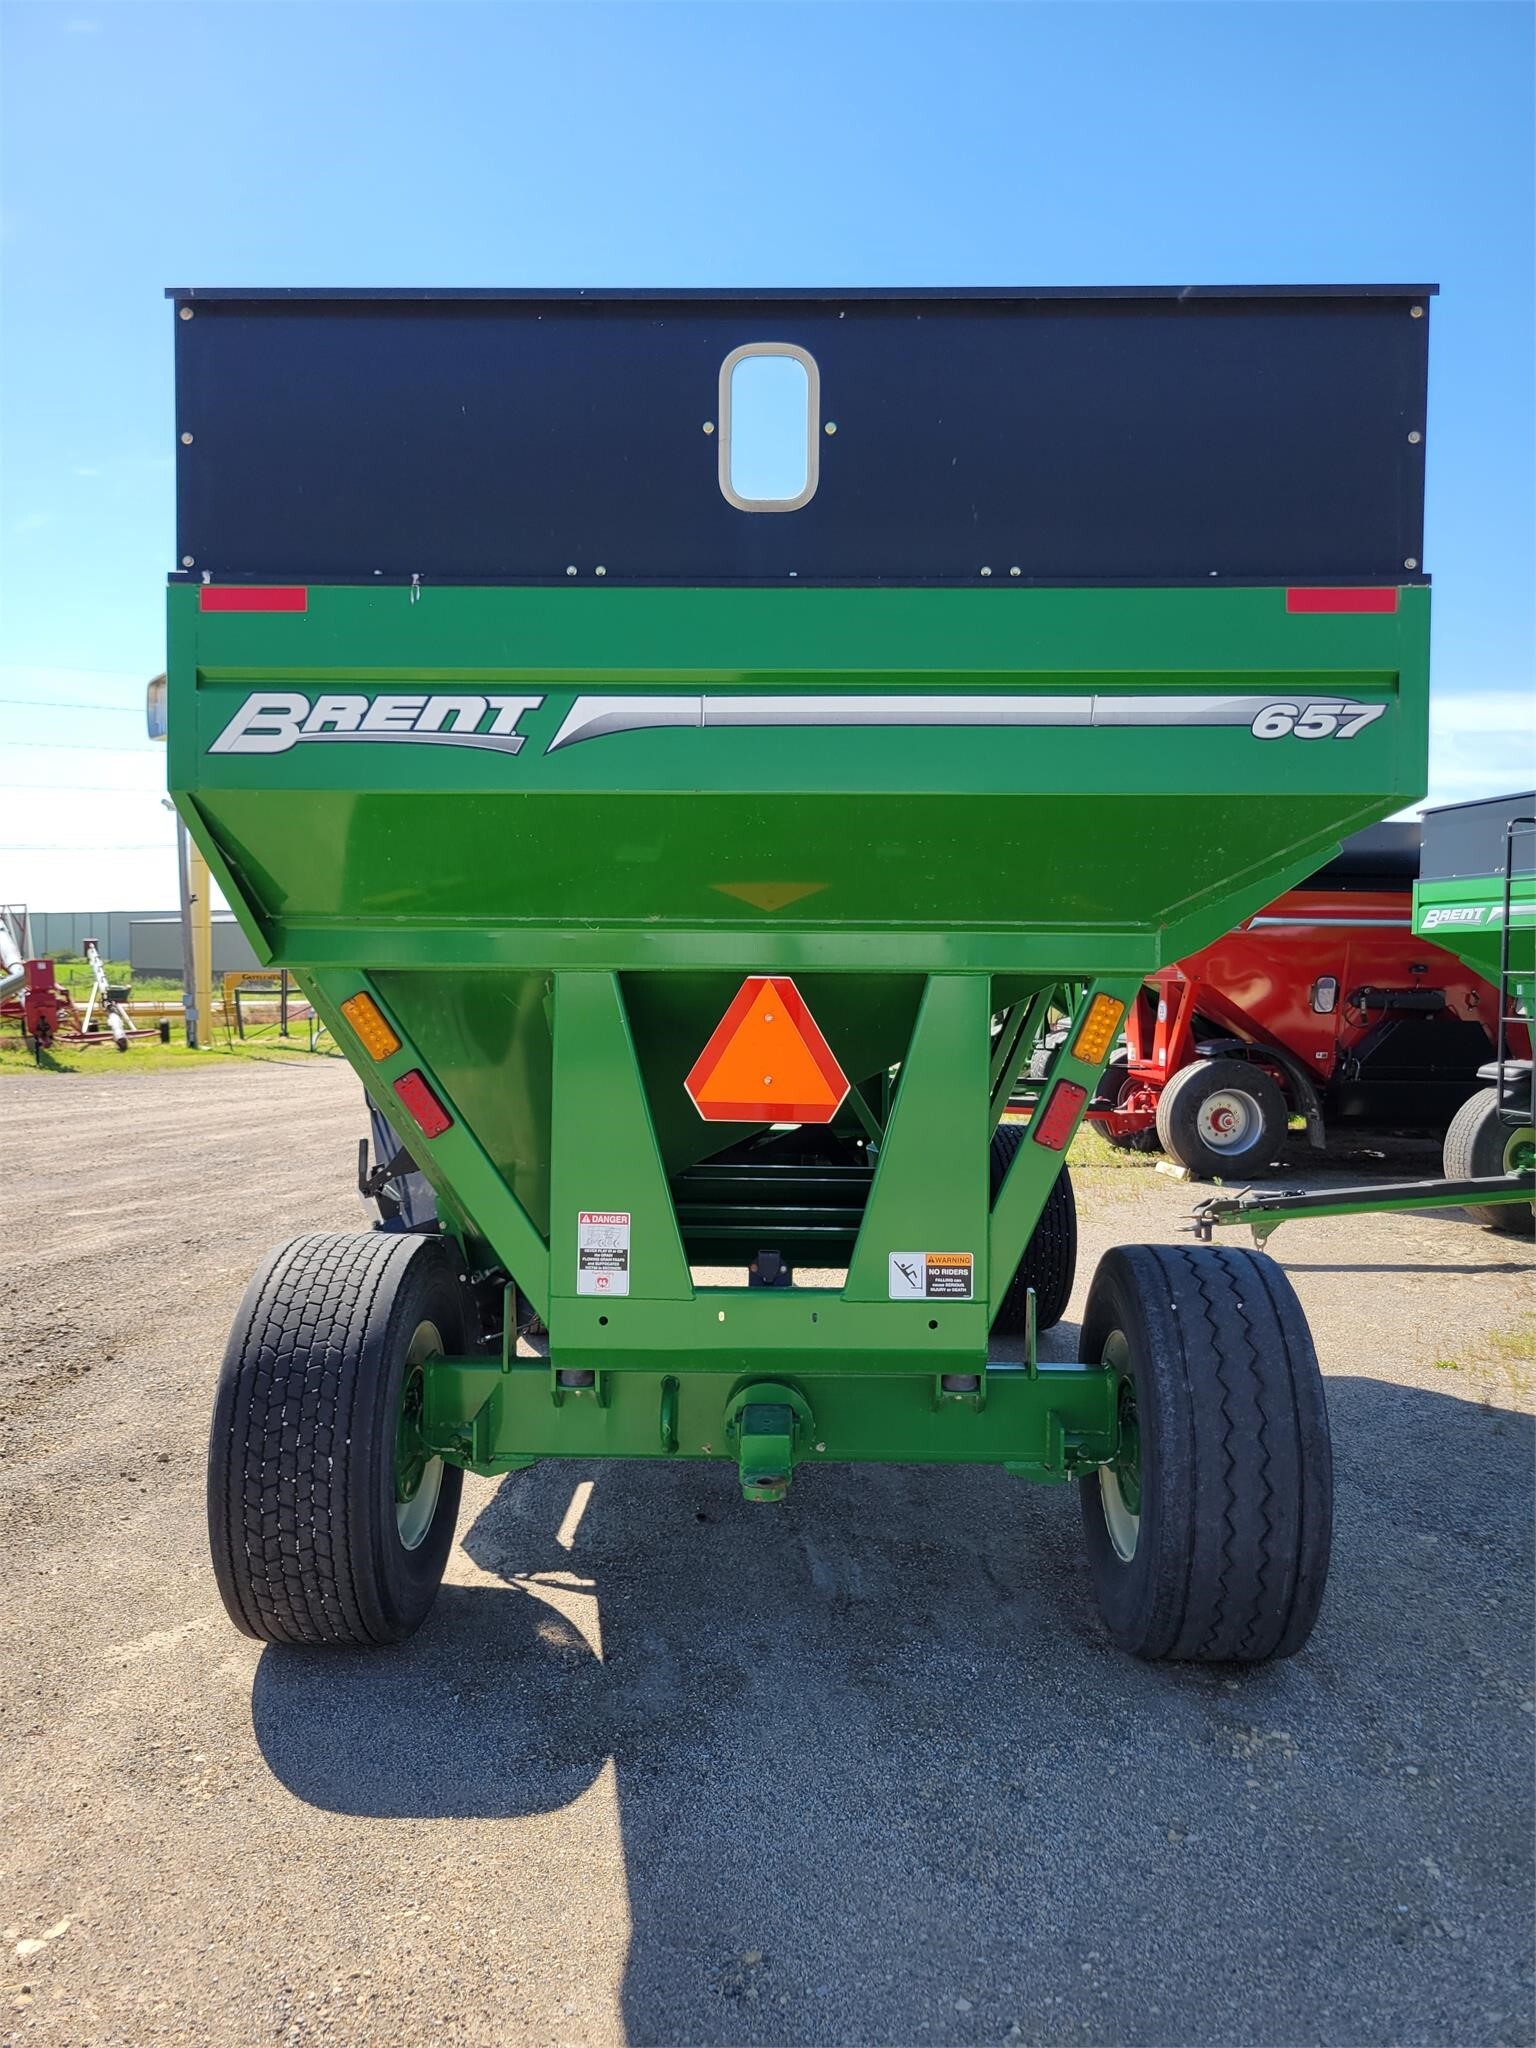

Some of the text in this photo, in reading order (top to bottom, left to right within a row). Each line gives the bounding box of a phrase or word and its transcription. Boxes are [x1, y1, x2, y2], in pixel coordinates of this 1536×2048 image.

[206, 691, 548, 754] BRENT
[1251, 703, 1389, 740] 657
[1421, 907, 1488, 928] BRENT
[592, 1215, 628, 1224] DANGER
